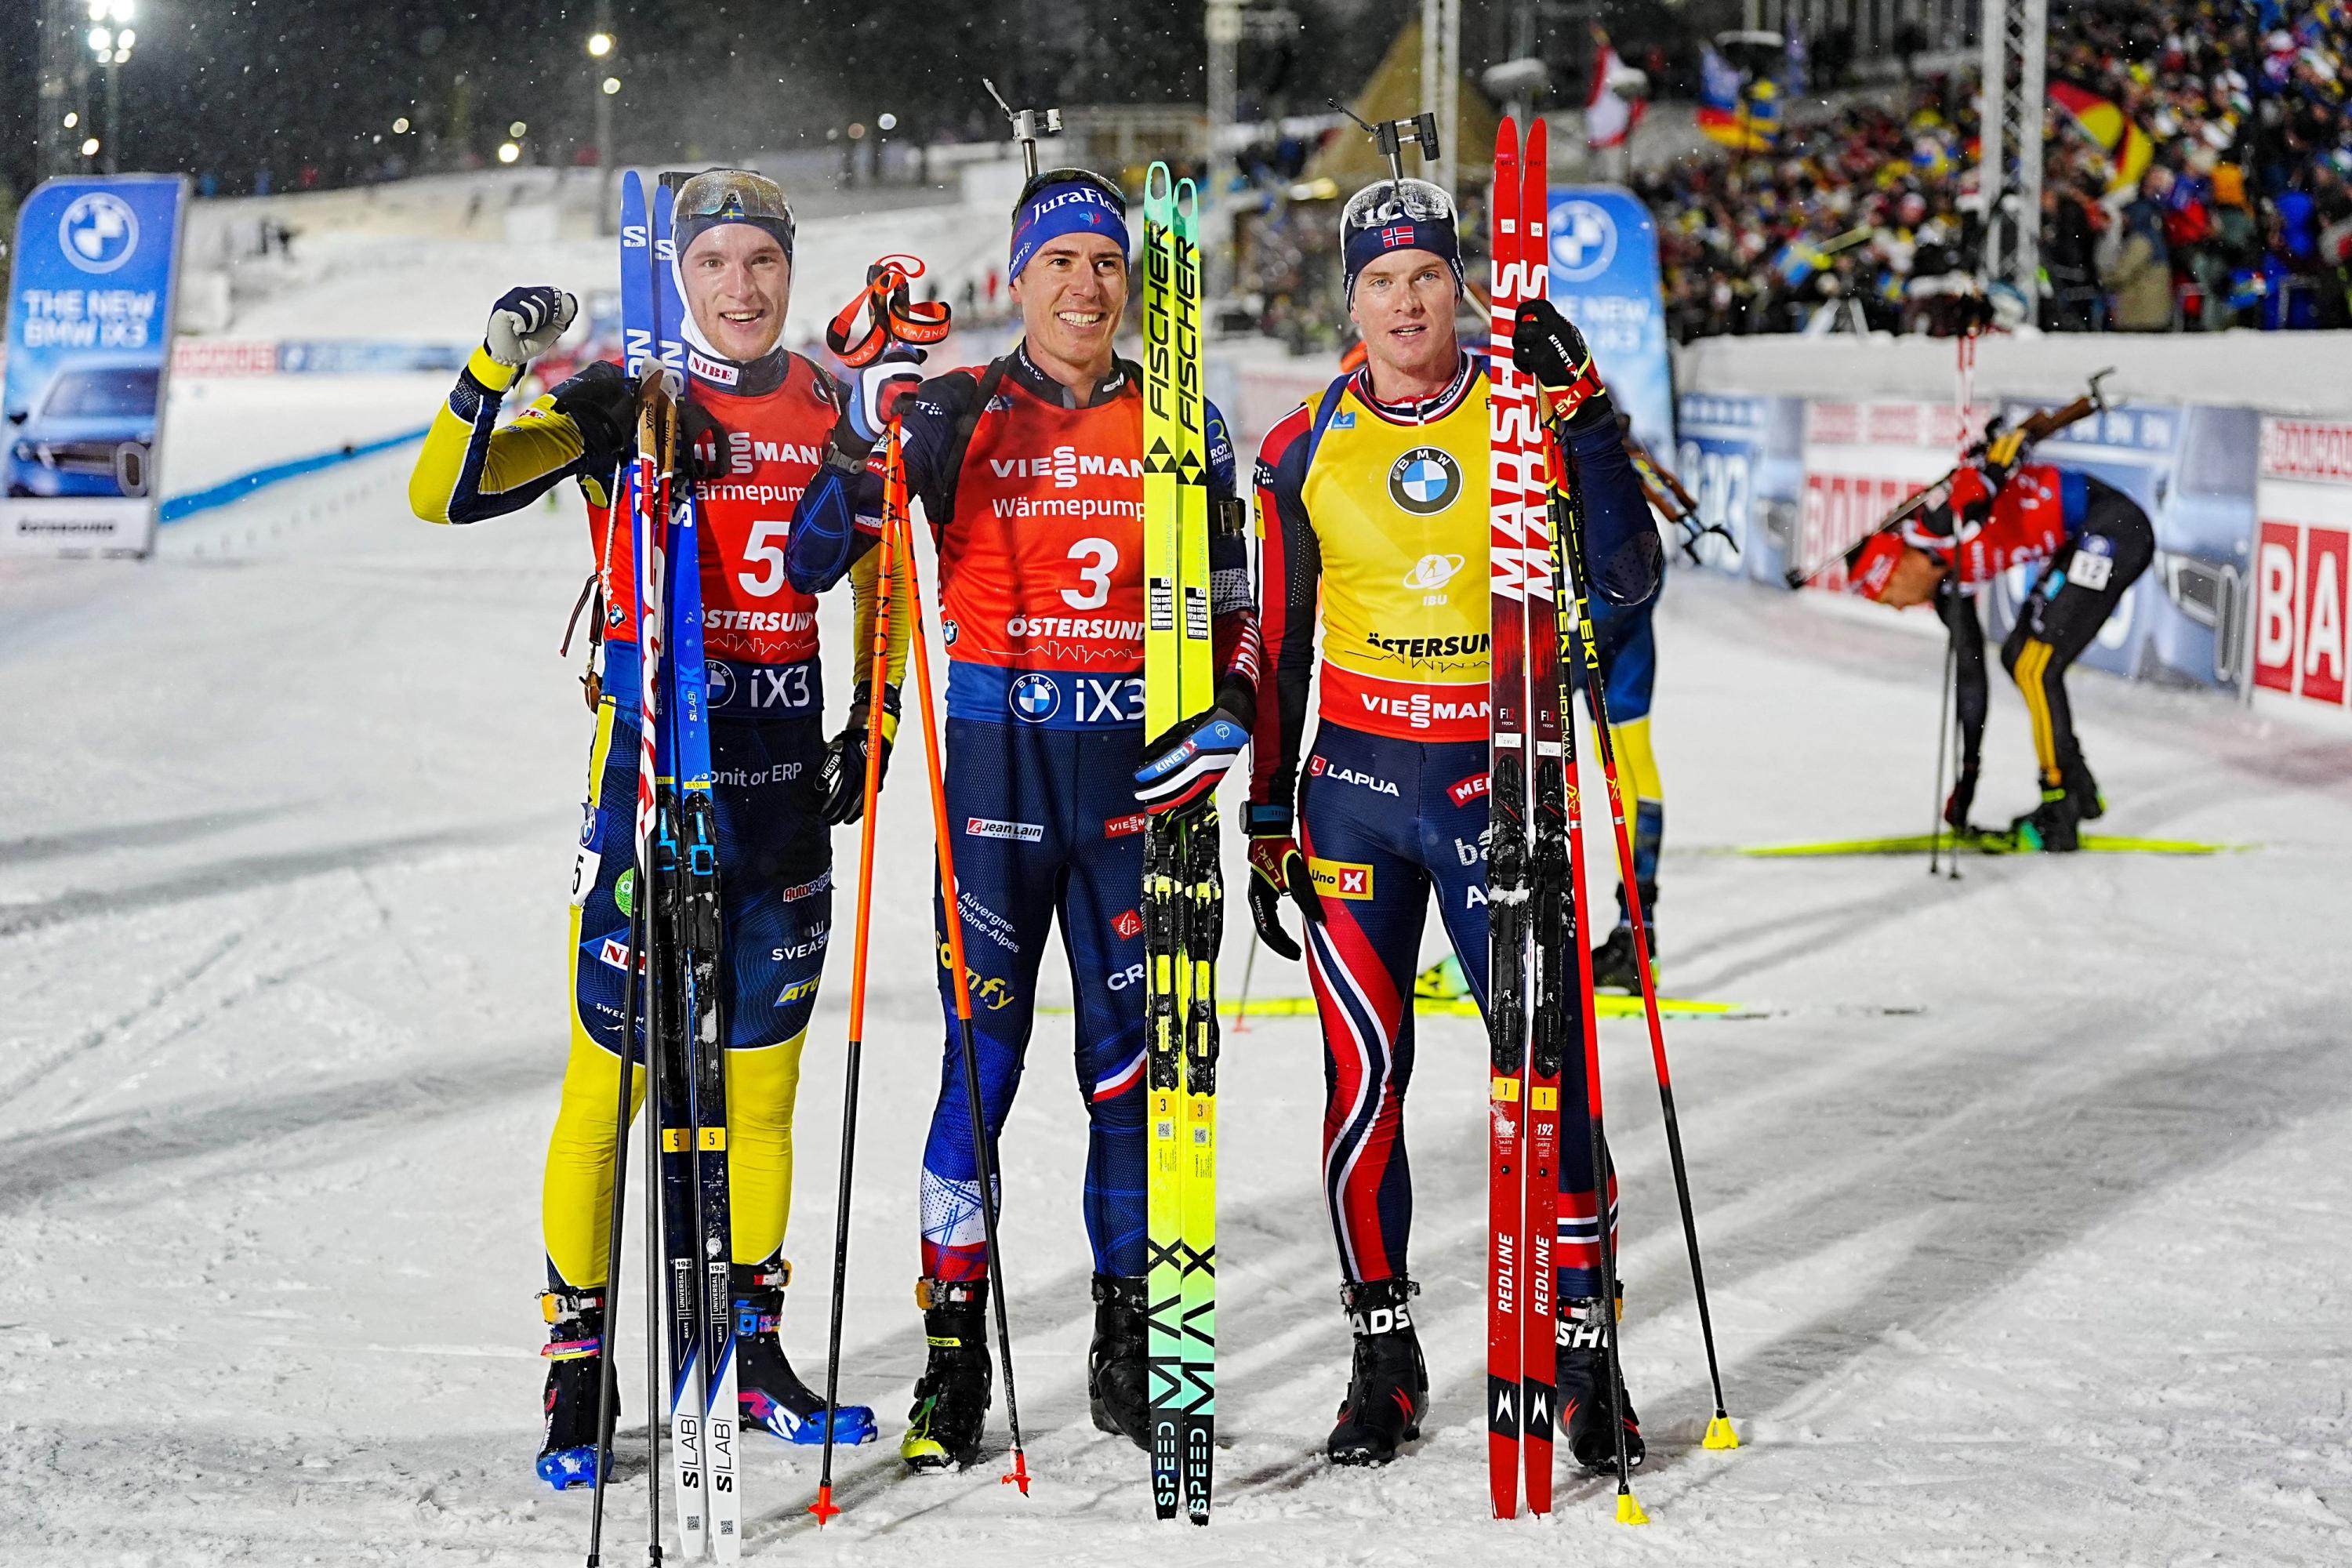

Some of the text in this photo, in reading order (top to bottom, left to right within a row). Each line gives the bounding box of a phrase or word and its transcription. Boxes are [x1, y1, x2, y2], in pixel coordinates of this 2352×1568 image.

[1011, 248, 1024, 272] RAFT
[1150, 225, 1169, 420] FISCHER
[1176, 236, 1198, 434] FISCHER
[691, 356, 732, 381] NIBE
[1548, 334, 1578, 377] KINETIX
[1555, 390, 1581, 416] EKI
[1490, 260, 1523, 602] MADSHUS
[1210, 442, 1228, 459] ROY
[1398, 449, 1450, 471] BMW
[989, 445, 1145, 488] VIESSMAN
[695, 481, 805, 505] ärmepum
[993, 498, 1145, 521] Wärmepump
[739, 521, 790, 597] 5
[1060, 537, 1119, 611] 3
[1423, 595, 1447, 606] IBU
[701, 604, 814, 632] STERSUND
[1557, 589, 1571, 663] LEKI
[1367, 632, 1490, 658] ÖSTERSUN
[1576, 597, 1599, 669] LEKI
[751, 666, 809, 707] iX3
[1076, 679, 1145, 722] iX3
[1361, 694, 1490, 728] VIESSMAN
[822, 754, 841, 779] HESTRA
[1155, 739, 1197, 772] KINETIX
[711, 762, 802, 787] onitor ERP
[1327, 764, 1400, 797] LAPUA
[982, 822, 1041, 837] Jean Lain
[1109, 816, 1145, 833] VIESSM
[1455, 829, 1492, 866] ba
[572, 854, 584, 895] 5
[1311, 869, 1336, 886] Uno
[961, 892, 1016, 933] Auvergne-
[1504, 1083, 1508, 1095] 1
[1542, 1092, 1546, 1105] 1
[1160, 1098, 1166, 1112] 3
[1197, 1104, 1203, 1116] 3
[673, 1134, 679, 1146] 5
[710, 1131, 715, 1145] 5
[1537, 1123, 1553, 1135] 192
[1498, 1232, 1514, 1313] REDLINE
[1534, 1234, 1551, 1317] REDLINE
[1158, 1421, 1175, 1507] SPEED
[1189, 1428, 1207, 1515] SPEED
